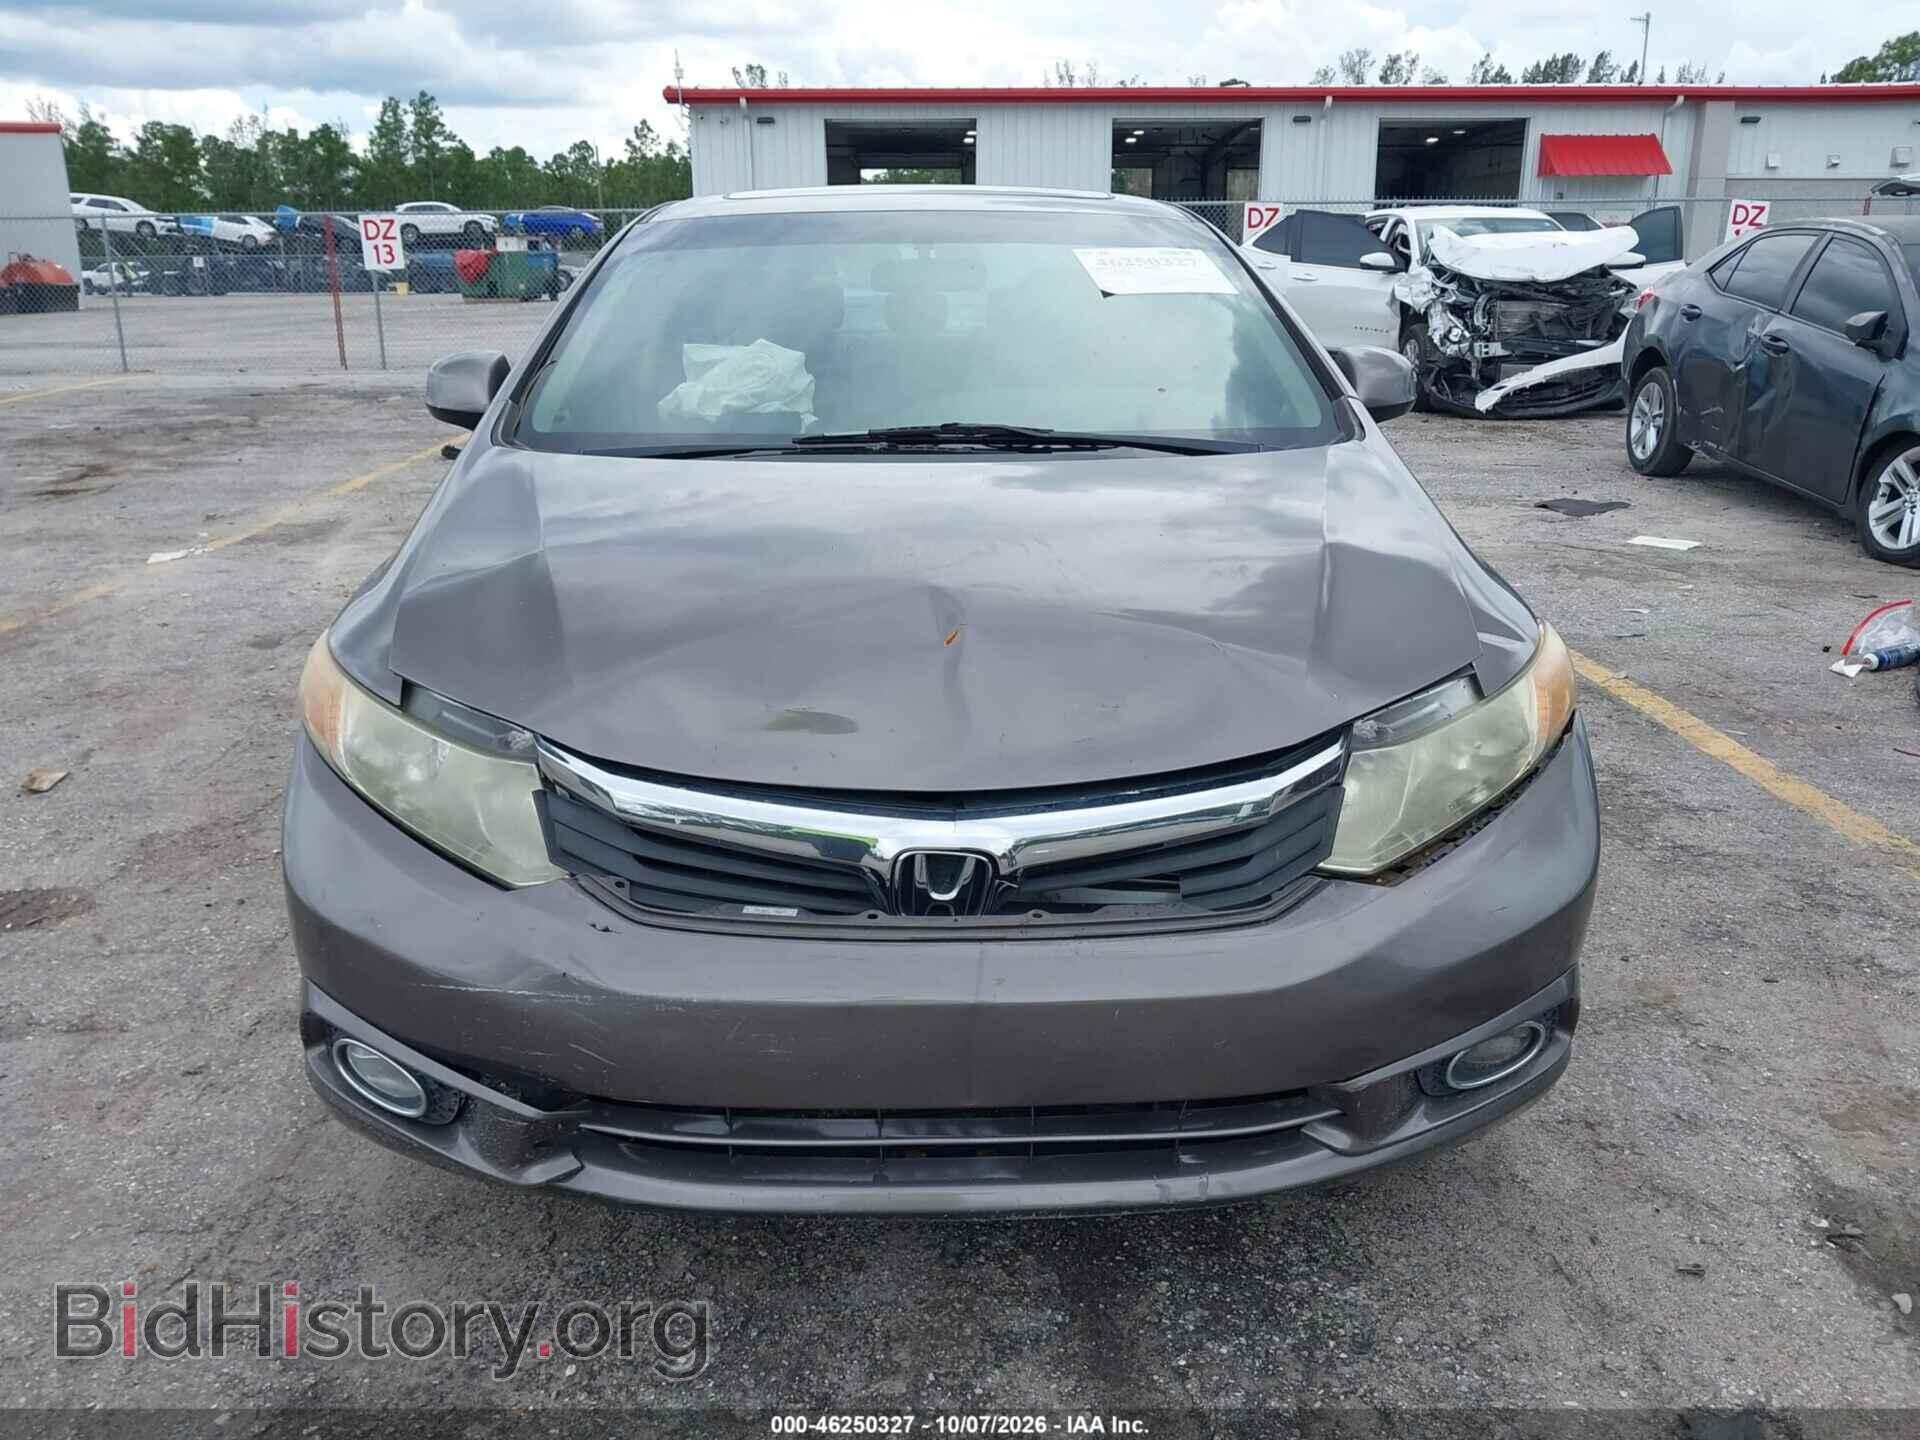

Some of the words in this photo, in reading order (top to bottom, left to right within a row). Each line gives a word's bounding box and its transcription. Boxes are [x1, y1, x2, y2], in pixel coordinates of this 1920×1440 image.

[1732, 204, 1766, 227] DZ
[362, 219, 397, 240] DZ
[373, 244, 395, 265] 13
